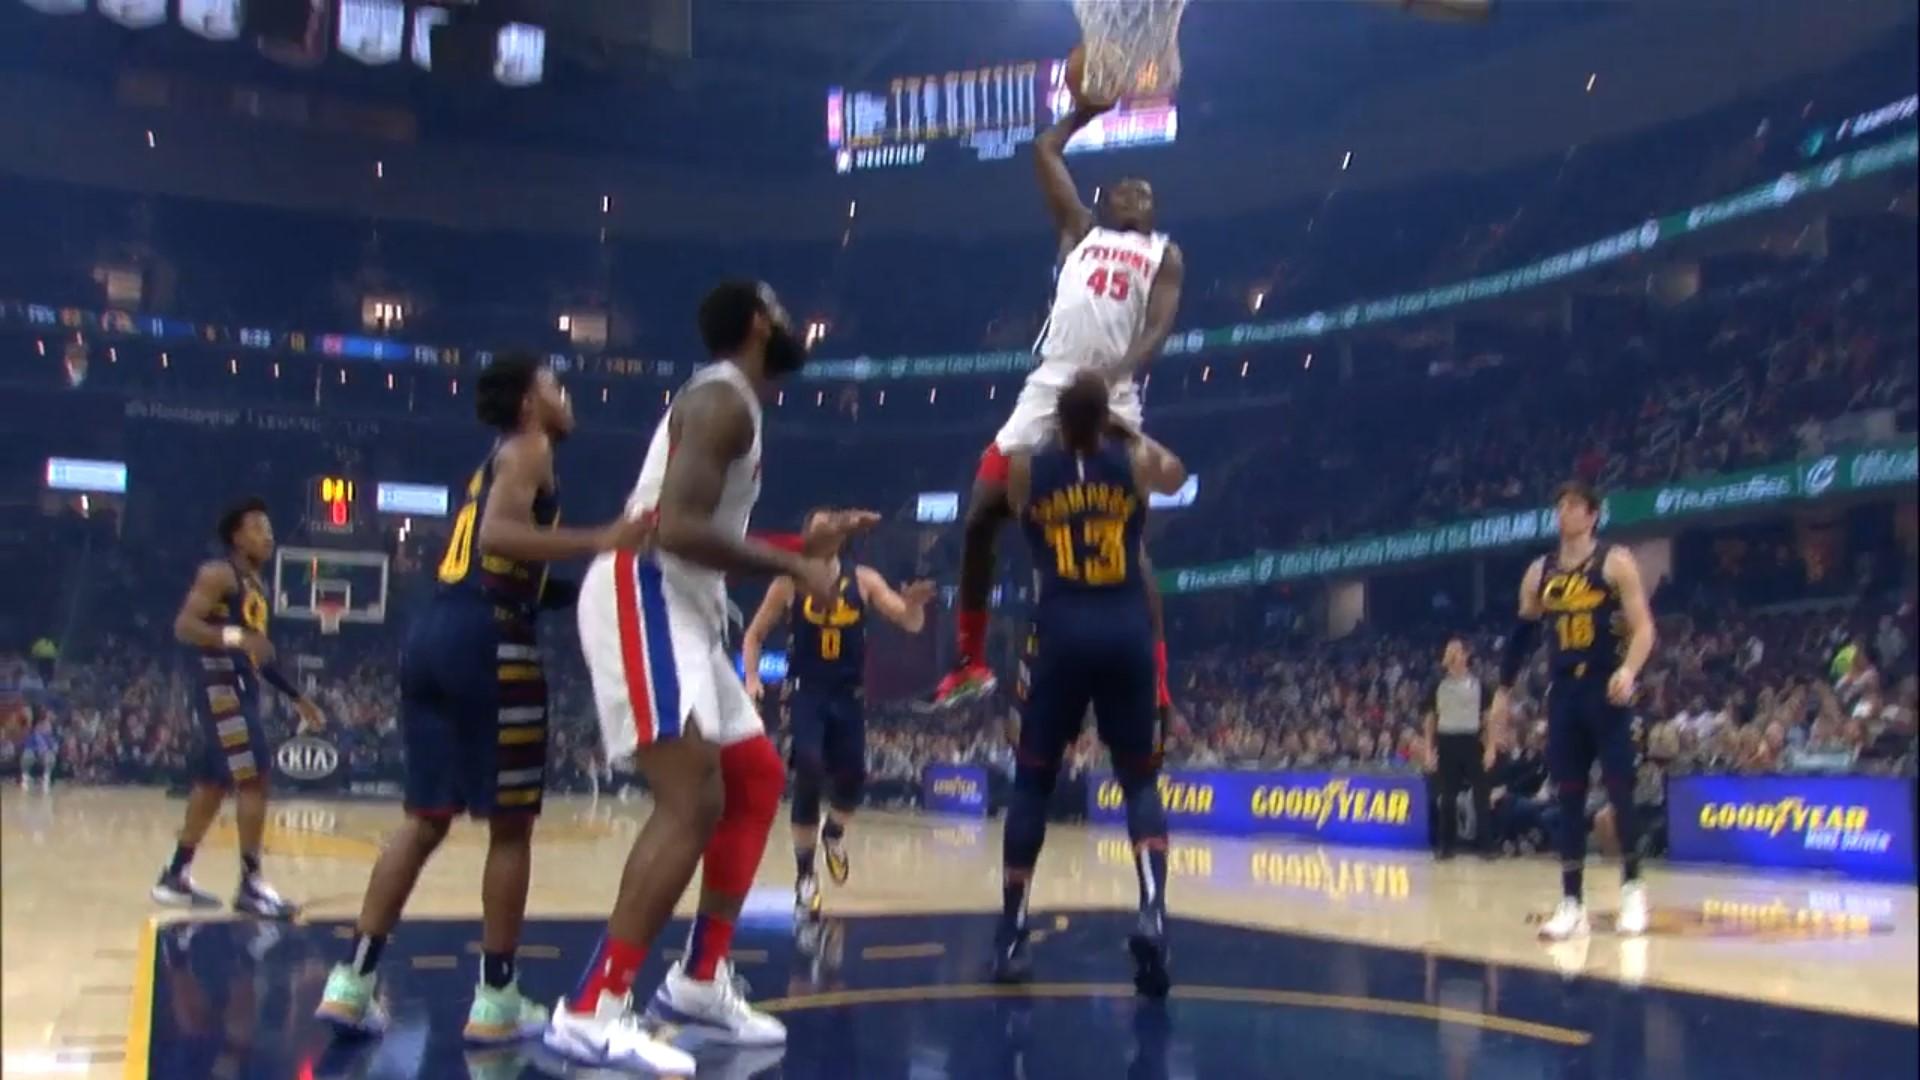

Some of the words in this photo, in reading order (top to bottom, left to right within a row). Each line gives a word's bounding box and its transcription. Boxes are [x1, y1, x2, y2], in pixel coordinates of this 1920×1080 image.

[1087, 266, 1130, 302] 45
[437, 502, 478, 584] 0
[1045, 518, 1127, 585] 13
[821, 628, 841, 660] 0
[1556, 610, 1595, 650] 16
[288, 746, 328, 769] KIA
[1251, 778, 1410, 831] GOODYEAR
[1699, 796, 1868, 839] GOODYEAR
